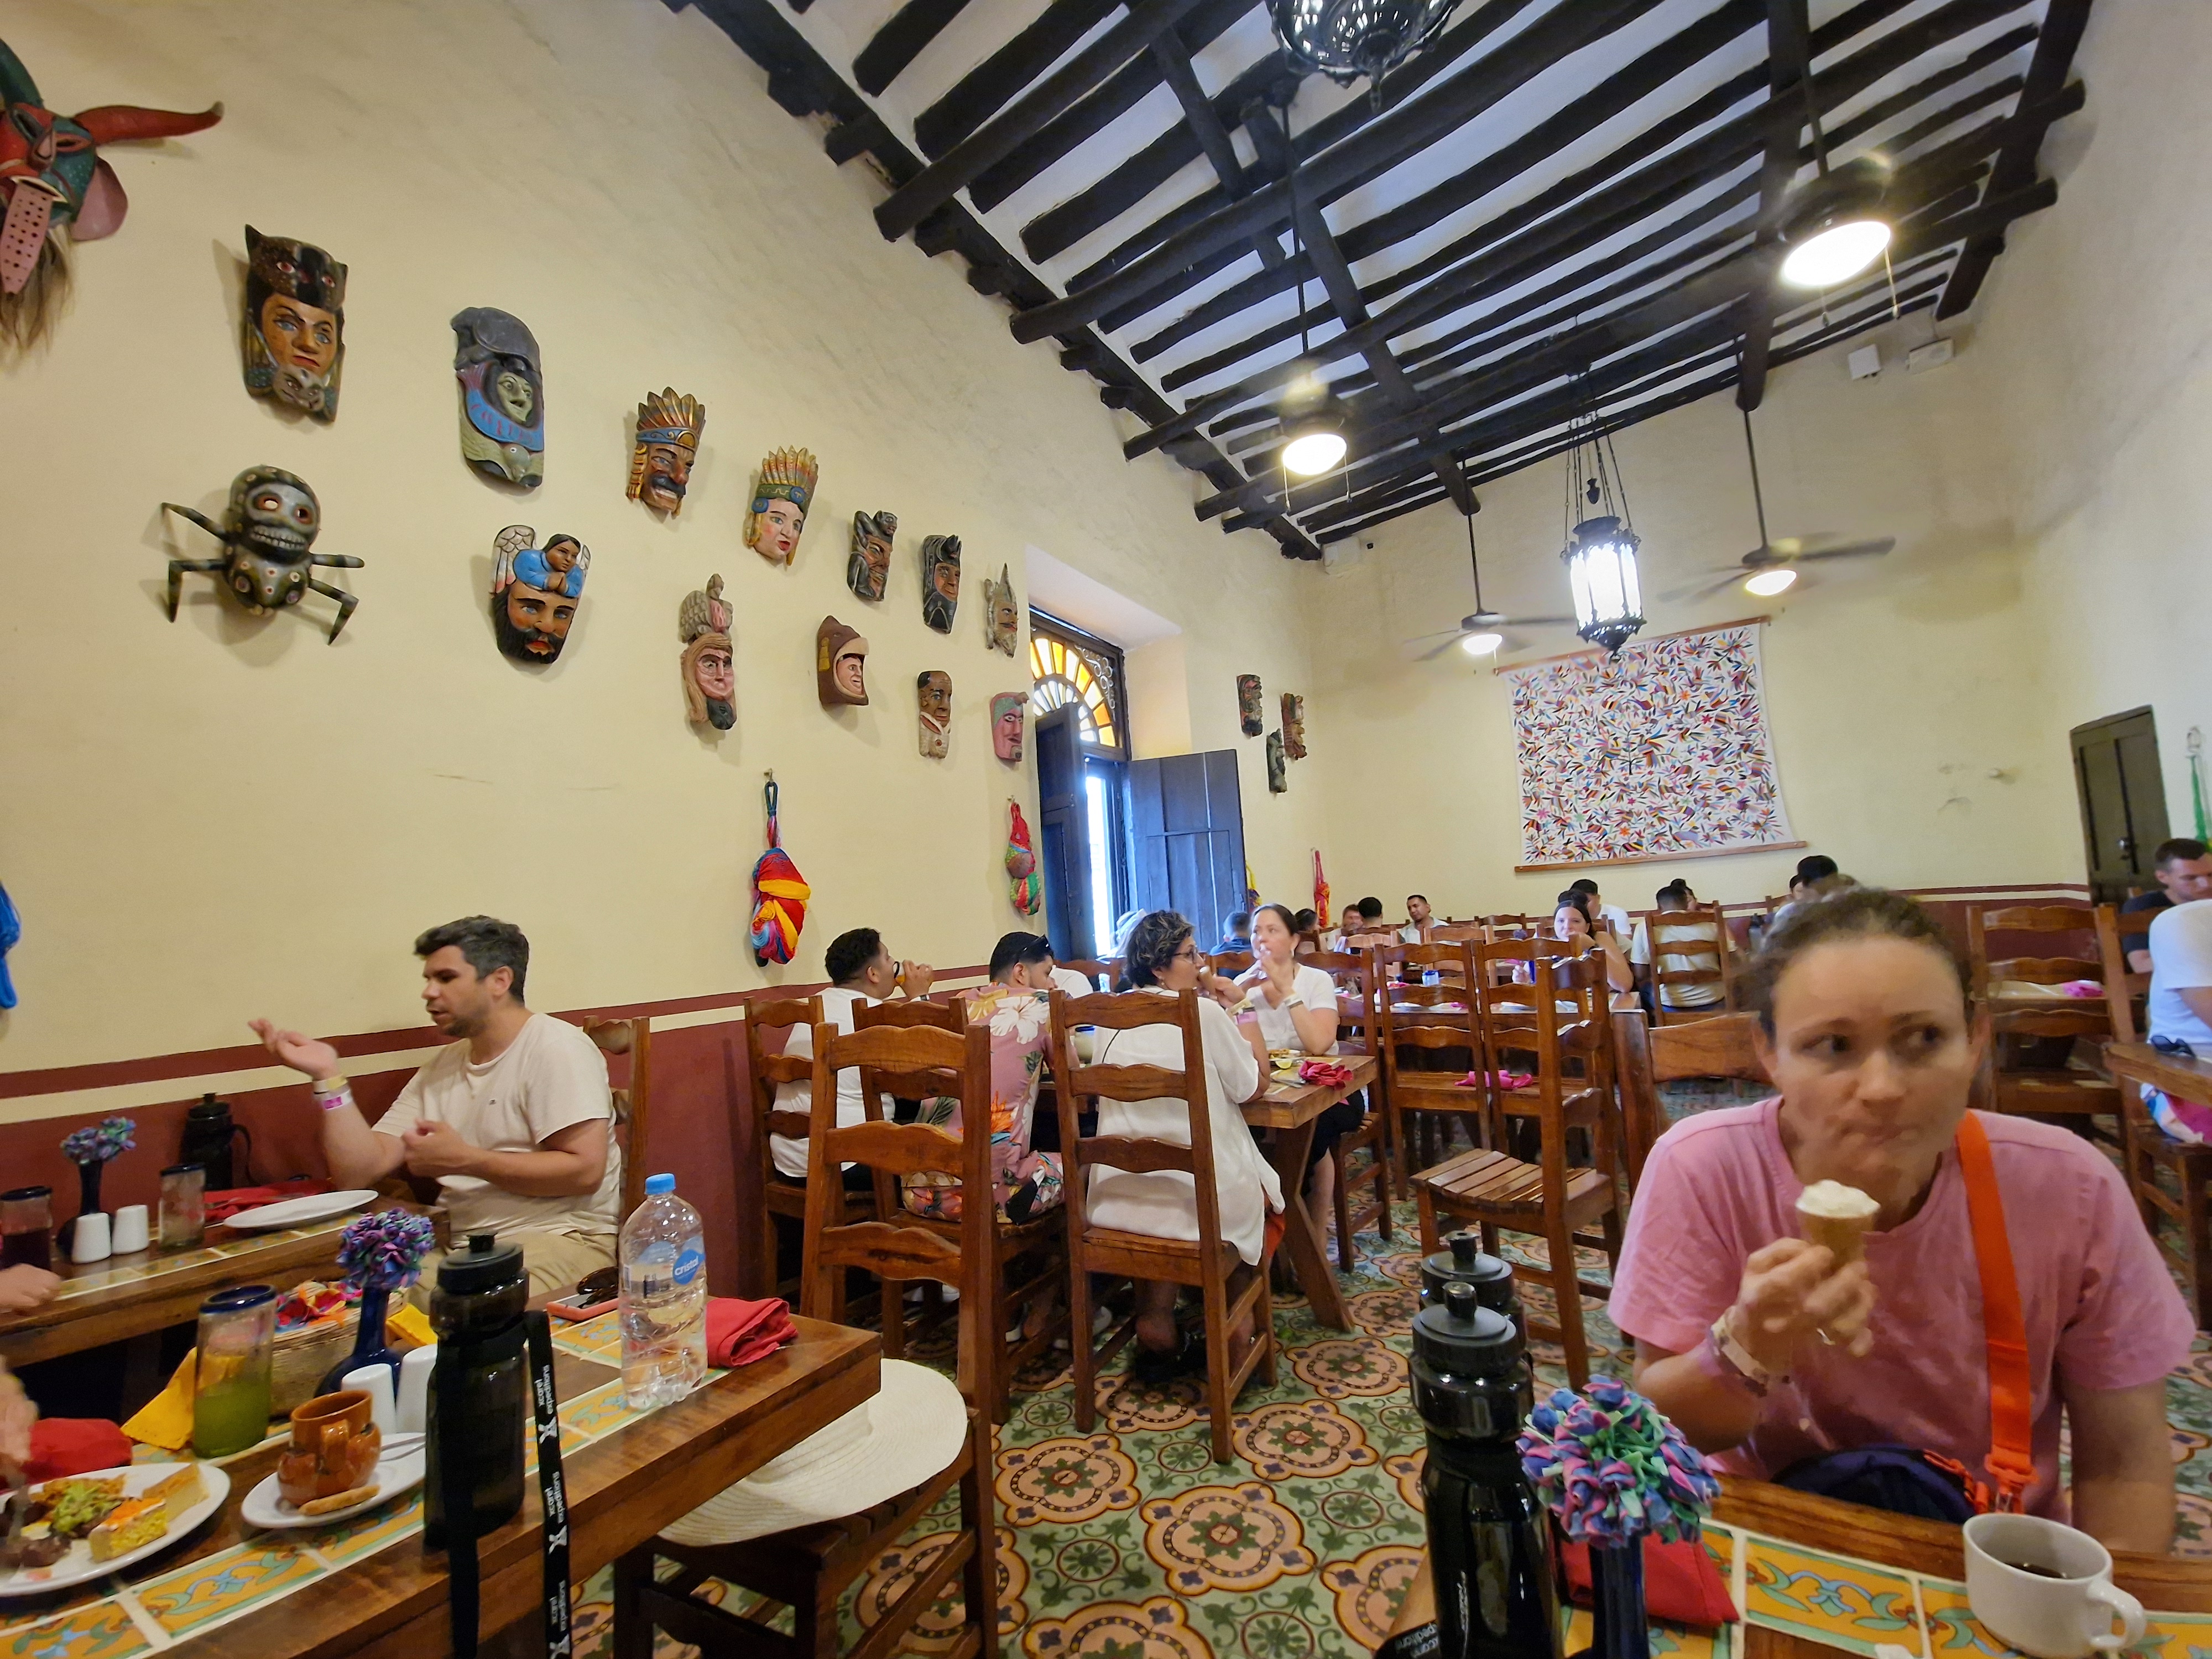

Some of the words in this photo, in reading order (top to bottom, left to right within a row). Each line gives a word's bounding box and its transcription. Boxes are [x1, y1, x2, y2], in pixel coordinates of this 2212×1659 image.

[675, 1255, 698, 1275] cristal
[534, 1379, 545, 1407] xcaret
[543, 1364, 555, 1415] expeditions
